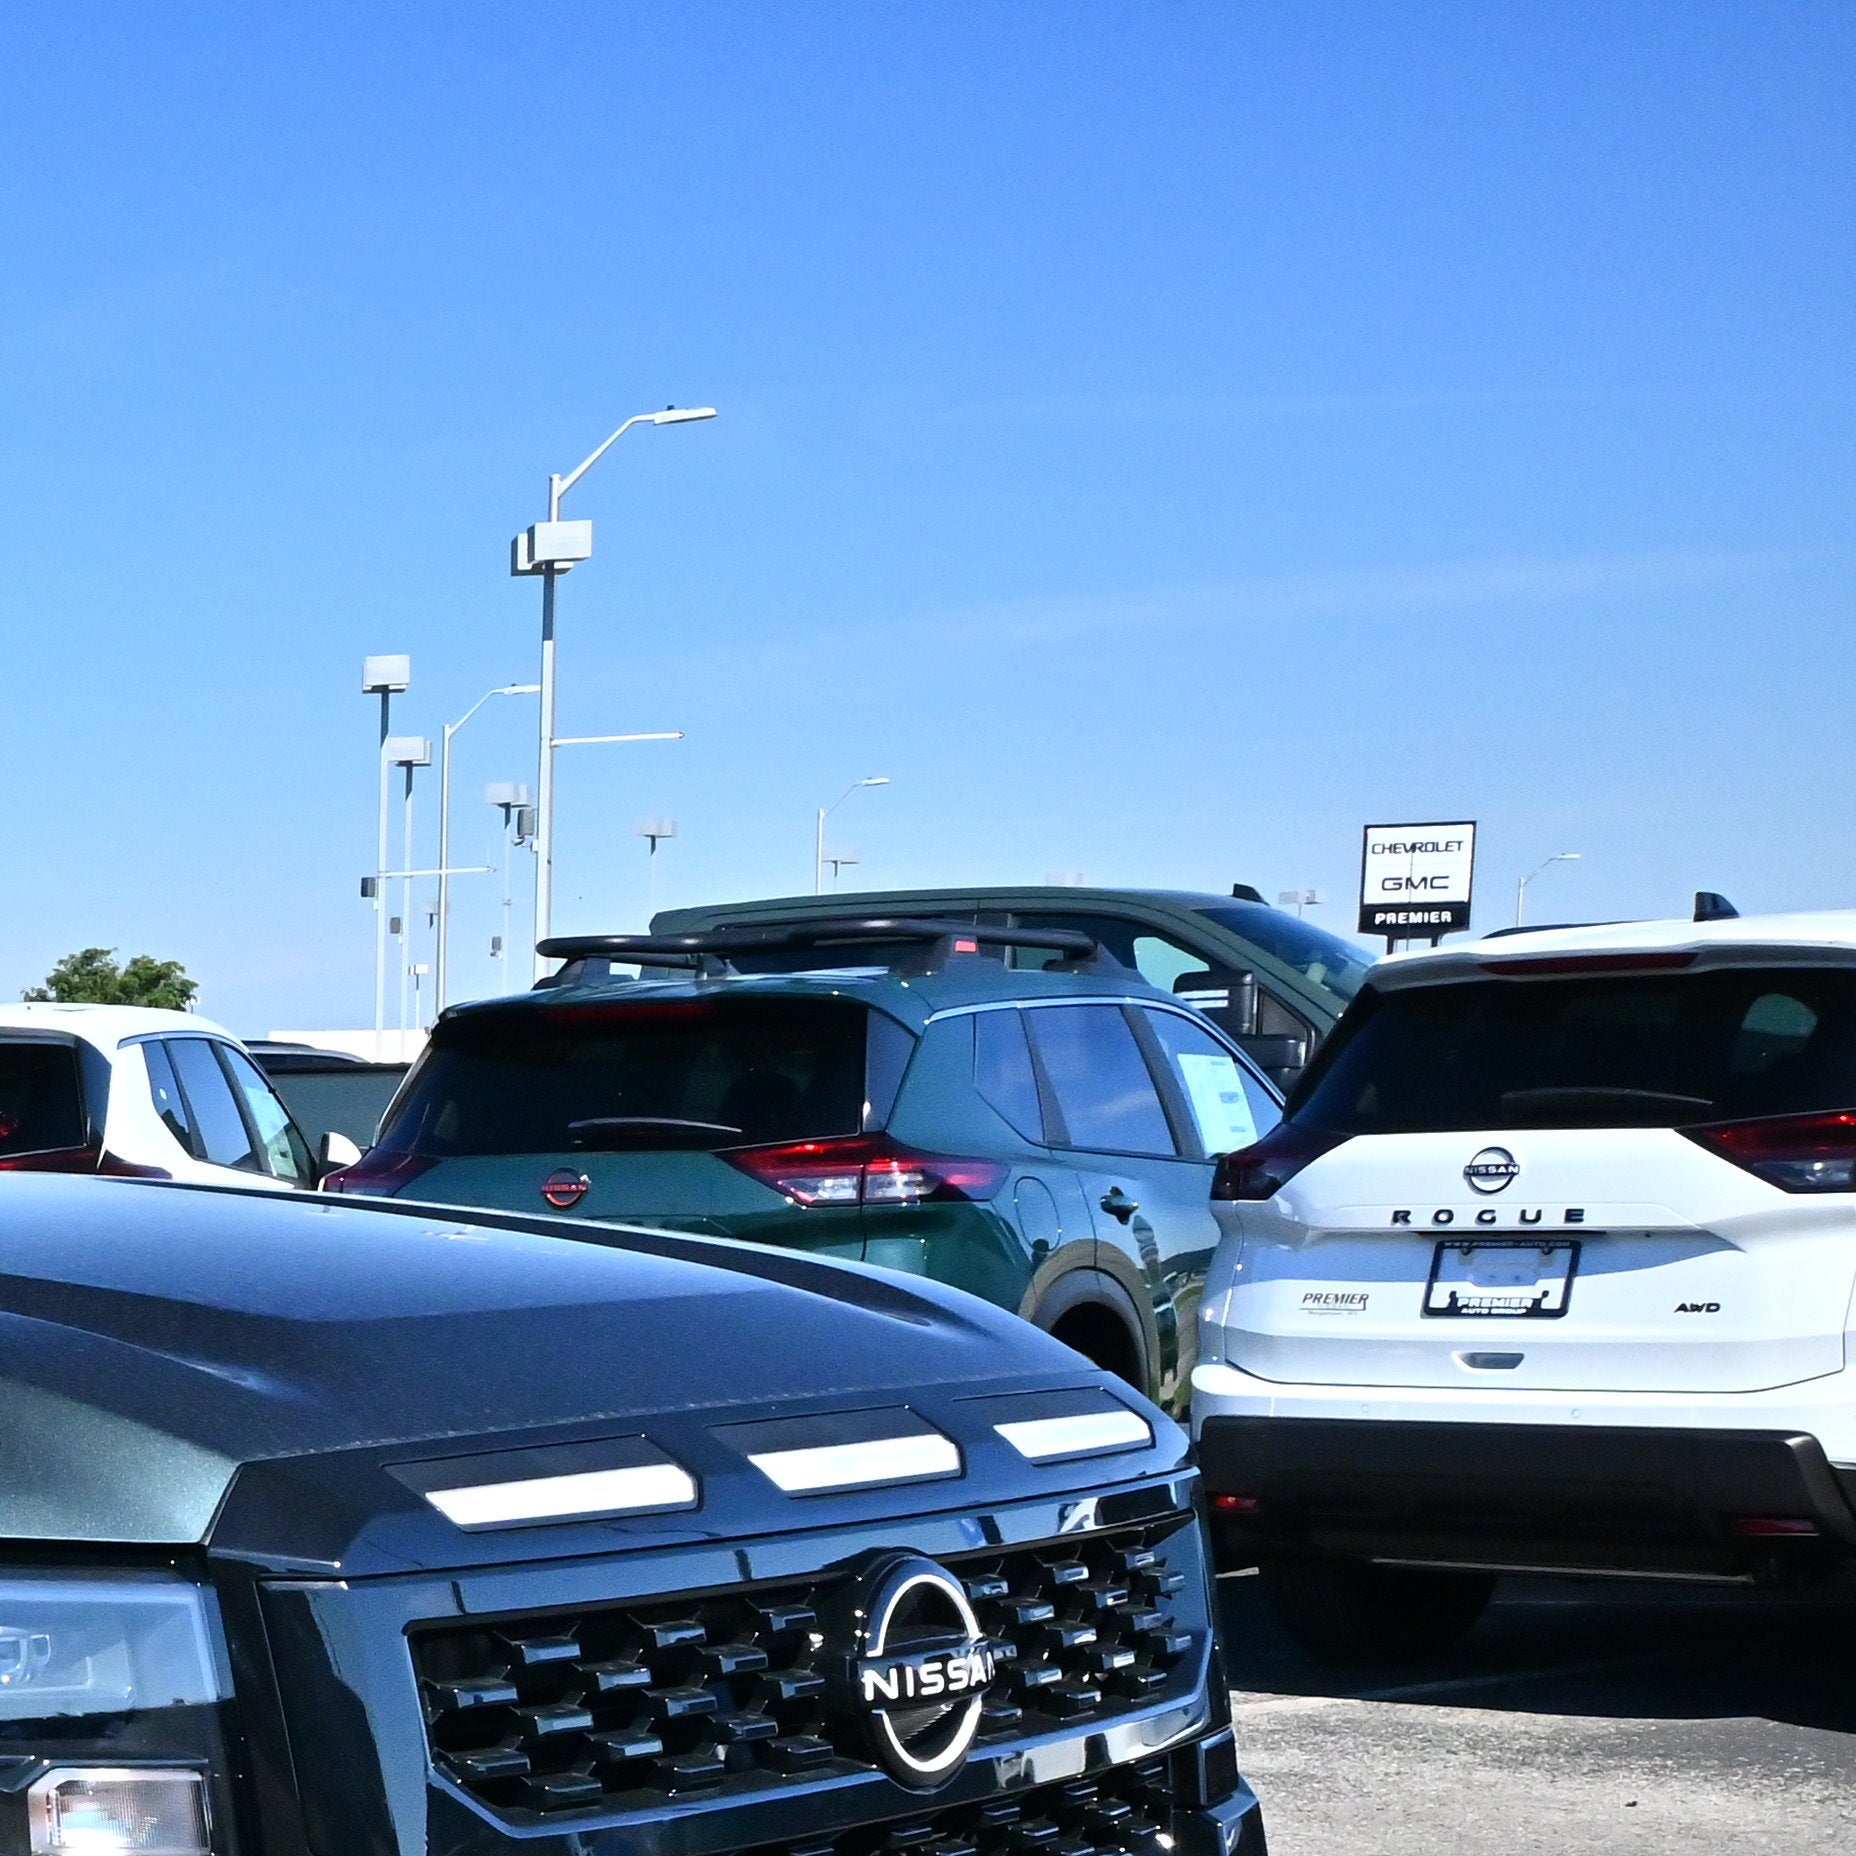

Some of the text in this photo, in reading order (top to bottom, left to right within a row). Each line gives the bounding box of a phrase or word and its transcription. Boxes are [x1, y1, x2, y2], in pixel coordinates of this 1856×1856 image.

[1371, 840, 1464, 855] CHEVROLET
[1381, 875, 1450, 891] GMC
[1374, 910, 1452, 925] PREMIER
[1464, 1164, 1519, 1176] NISSAN
[1391, 1209, 1585, 1225] ROGUE
[1302, 1292, 1369, 1305] PREMIER
[1456, 1297, 1534, 1309] PREMIER
[1674, 1303, 1721, 1313] AWD
[860, 1650, 996, 1702] NISSAN
